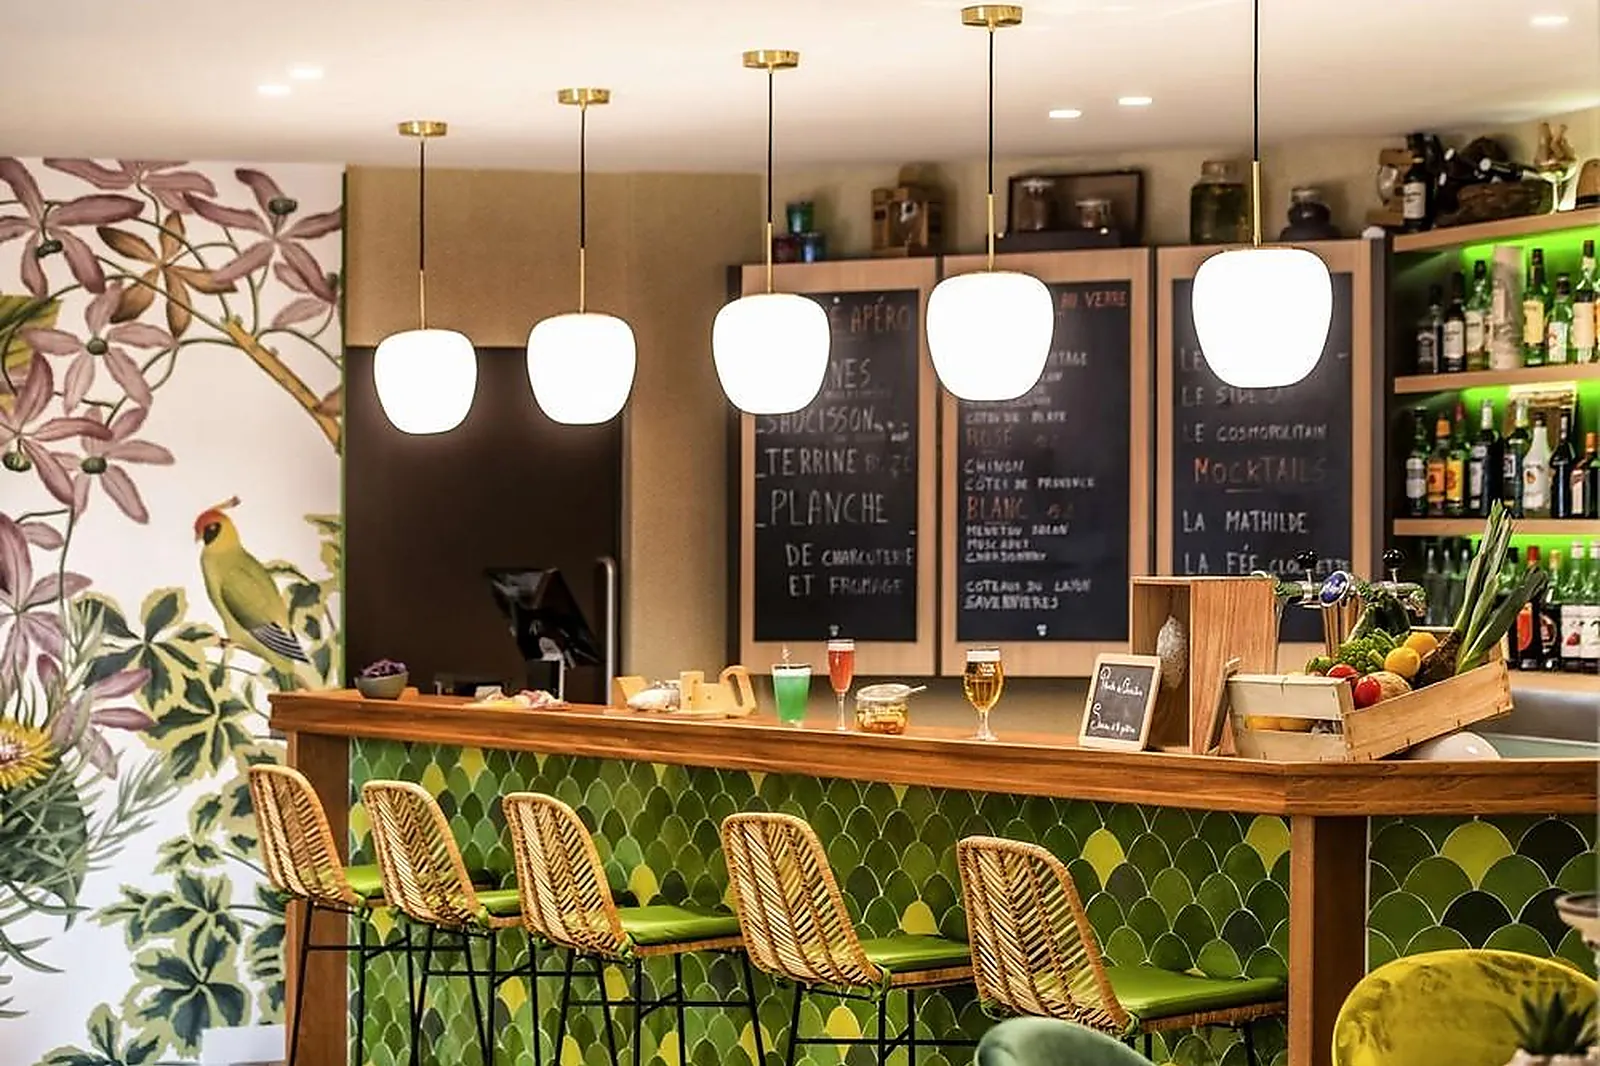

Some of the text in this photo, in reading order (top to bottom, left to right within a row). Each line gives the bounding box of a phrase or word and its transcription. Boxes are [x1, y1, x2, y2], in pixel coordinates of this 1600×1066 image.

[1182, 385, 1205, 407] LE
[764, 448, 857, 476] TERRINE
[771, 489, 888, 526] PLANCHE
[967, 496, 1028, 519] BLANC
[1182, 509, 1309, 534] LA MATHILDE
[785, 542, 815, 567] DE
[1184, 552, 1209, 575] LA
[1226, 543, 1260, 575] FÉE
[788, 574, 815, 597] ET
